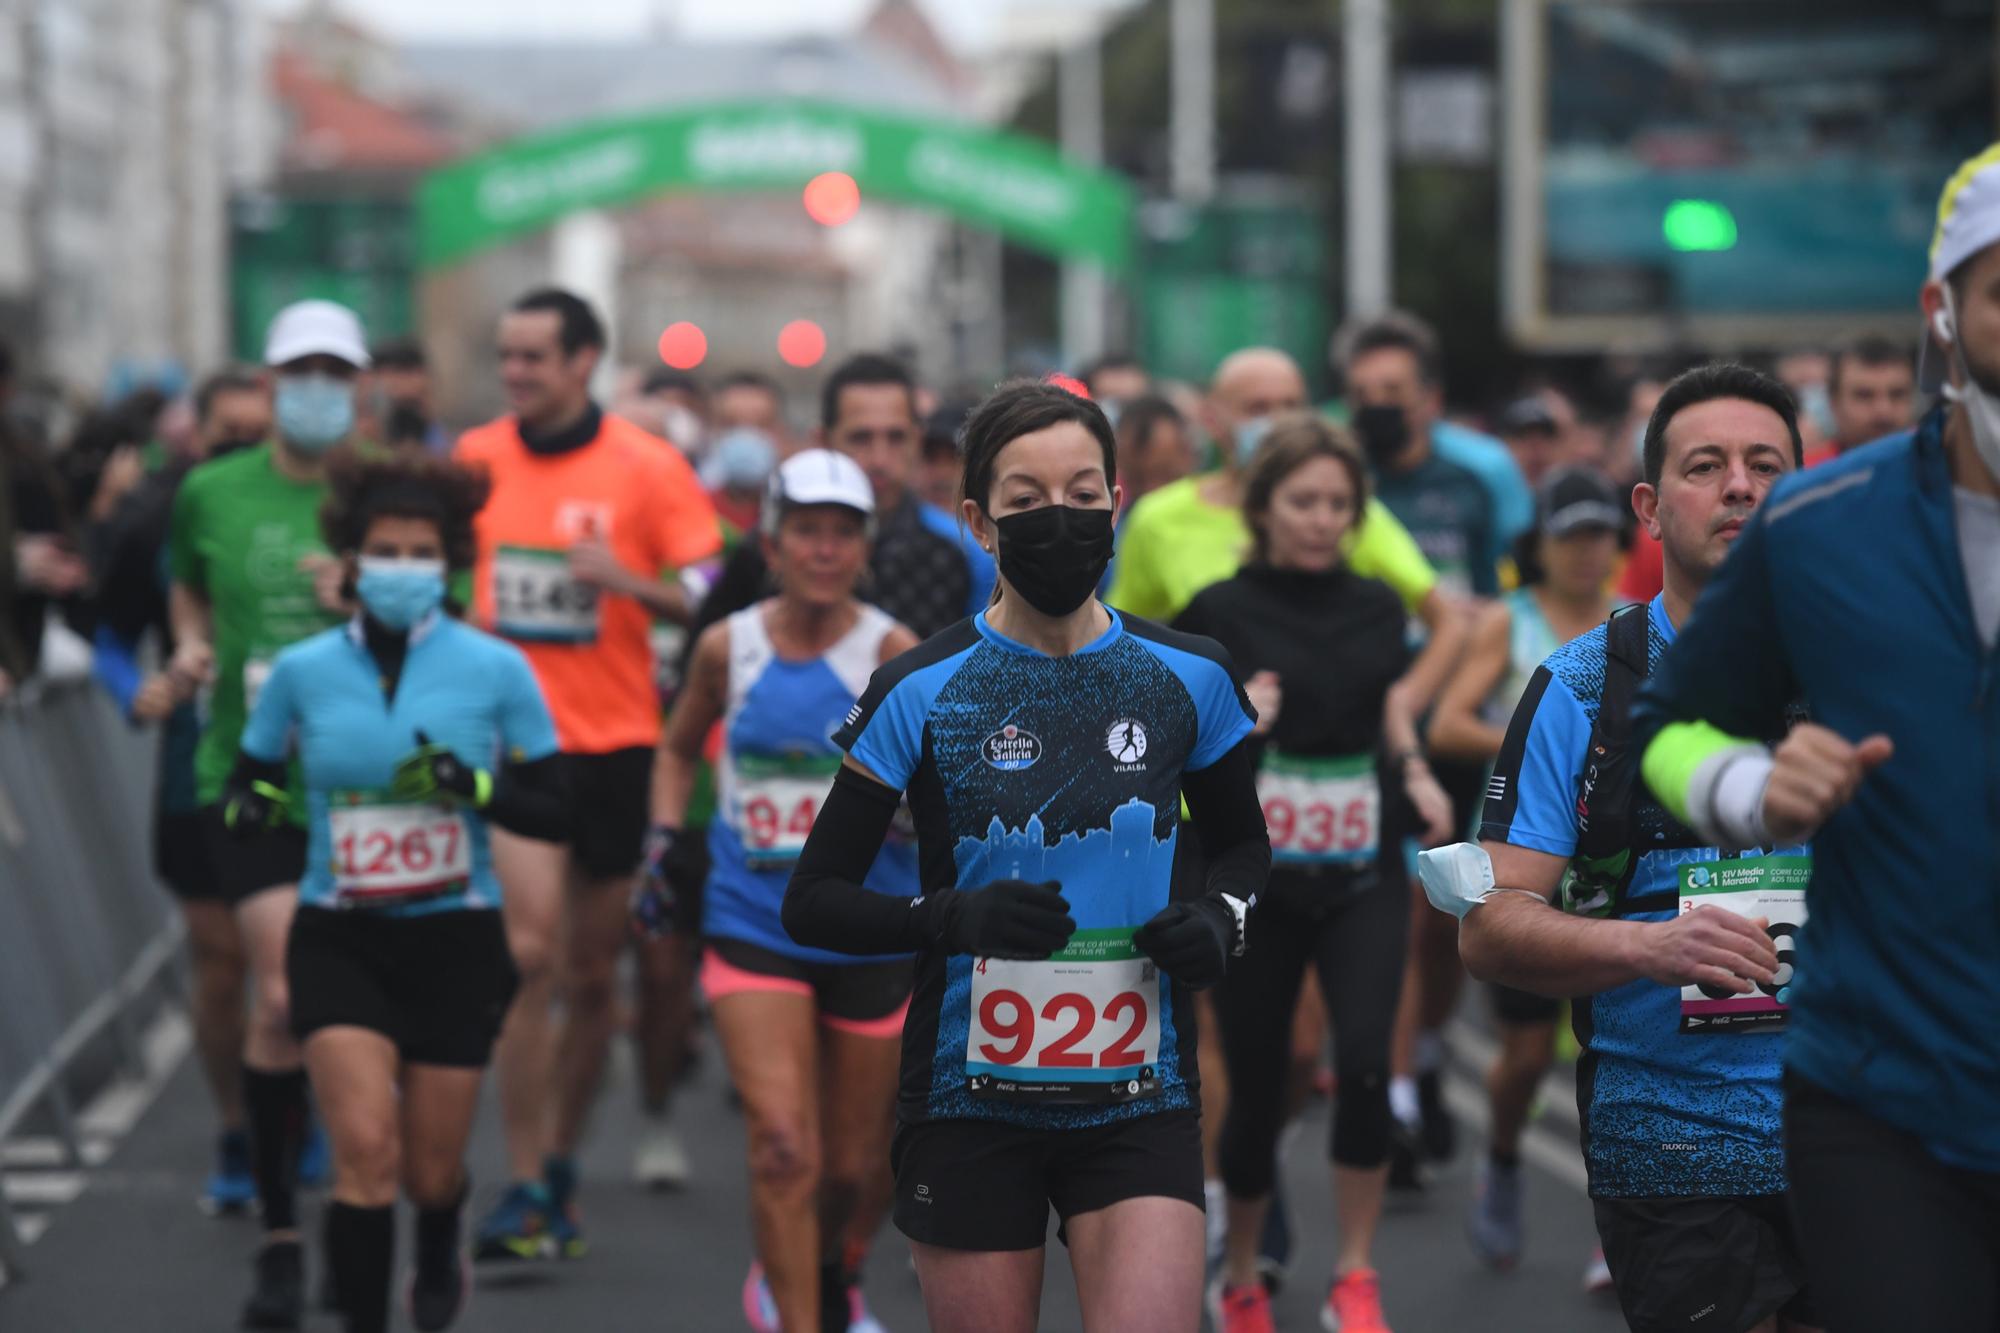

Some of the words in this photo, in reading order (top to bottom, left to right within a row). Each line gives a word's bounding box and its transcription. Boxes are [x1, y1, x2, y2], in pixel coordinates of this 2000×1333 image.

[991, 738, 1033, 750] Estrella
[992, 749, 1032, 761] Galicia
[1113, 763, 1147, 772] VILALBA
[1263, 797, 1370, 852] 935
[338, 820, 460, 876] 1267
[1722, 869, 1737, 879] XIV
[1737, 867, 1765, 878] Media
[976, 959, 987, 976] 4
[978, 988, 1148, 1067] 922
